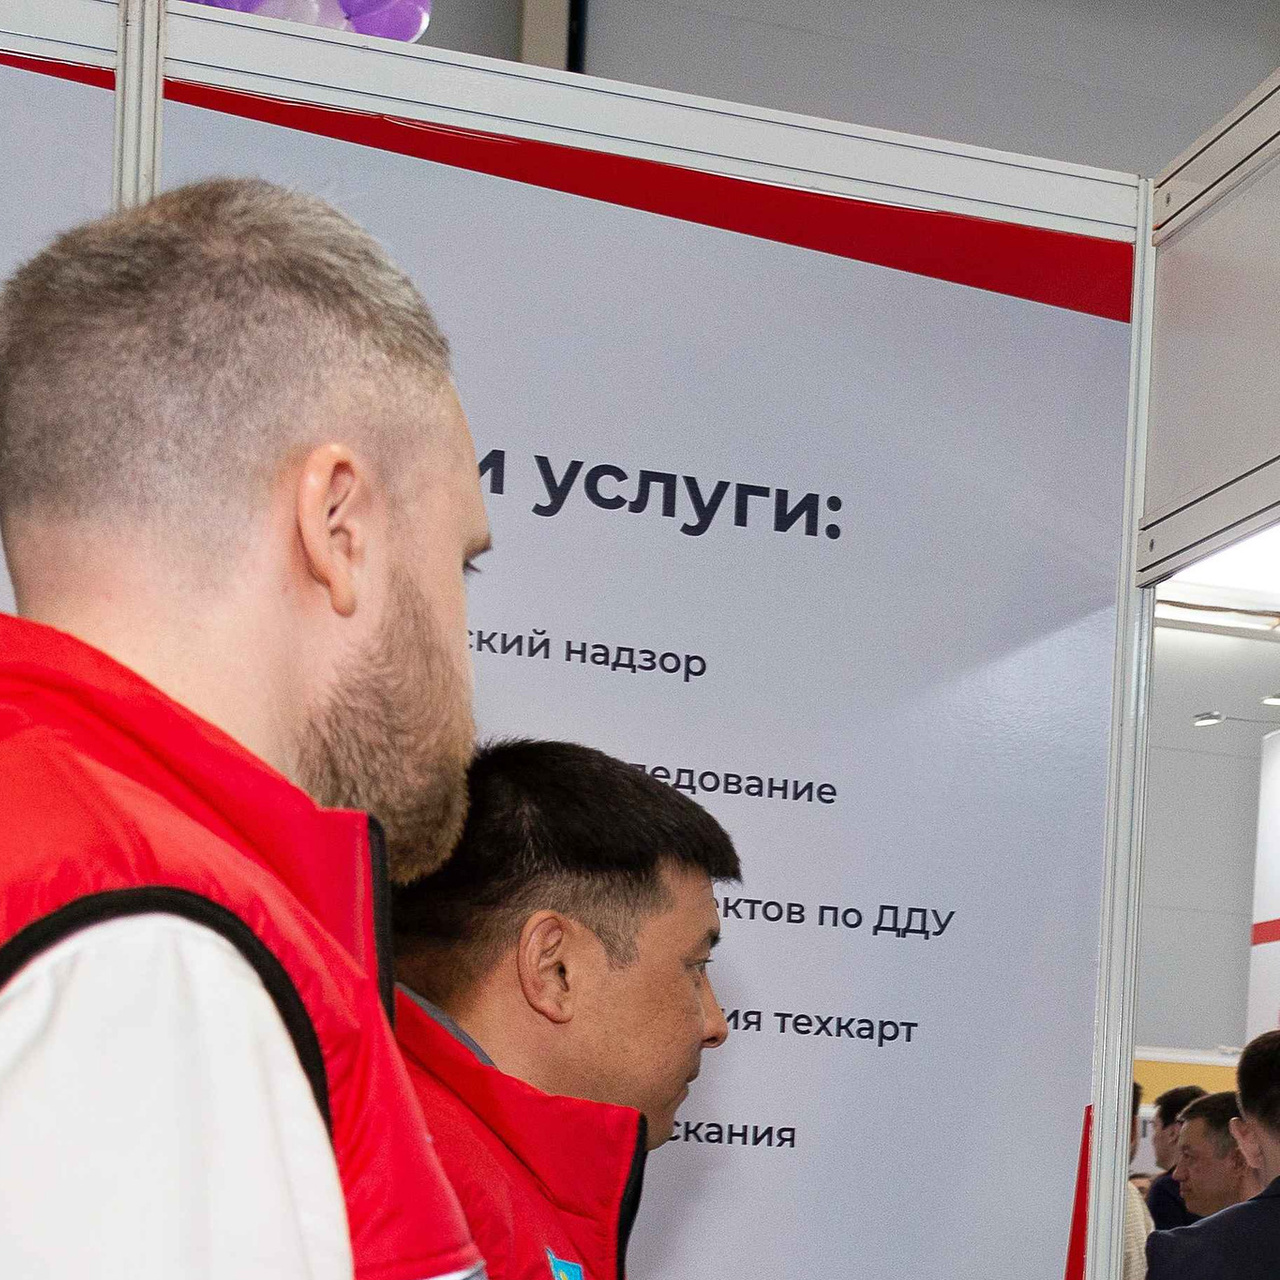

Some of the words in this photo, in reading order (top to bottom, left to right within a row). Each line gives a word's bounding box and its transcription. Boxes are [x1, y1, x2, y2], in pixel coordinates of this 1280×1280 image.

[531, 454, 843, 540] услуги:
[565, 639, 707, 682] надзор
[817, 904, 863, 930] по
[872, 904, 956, 940] ДДУ
[774, 1011, 919, 1048] техкарт
[669, 1119, 797, 1148] скания
